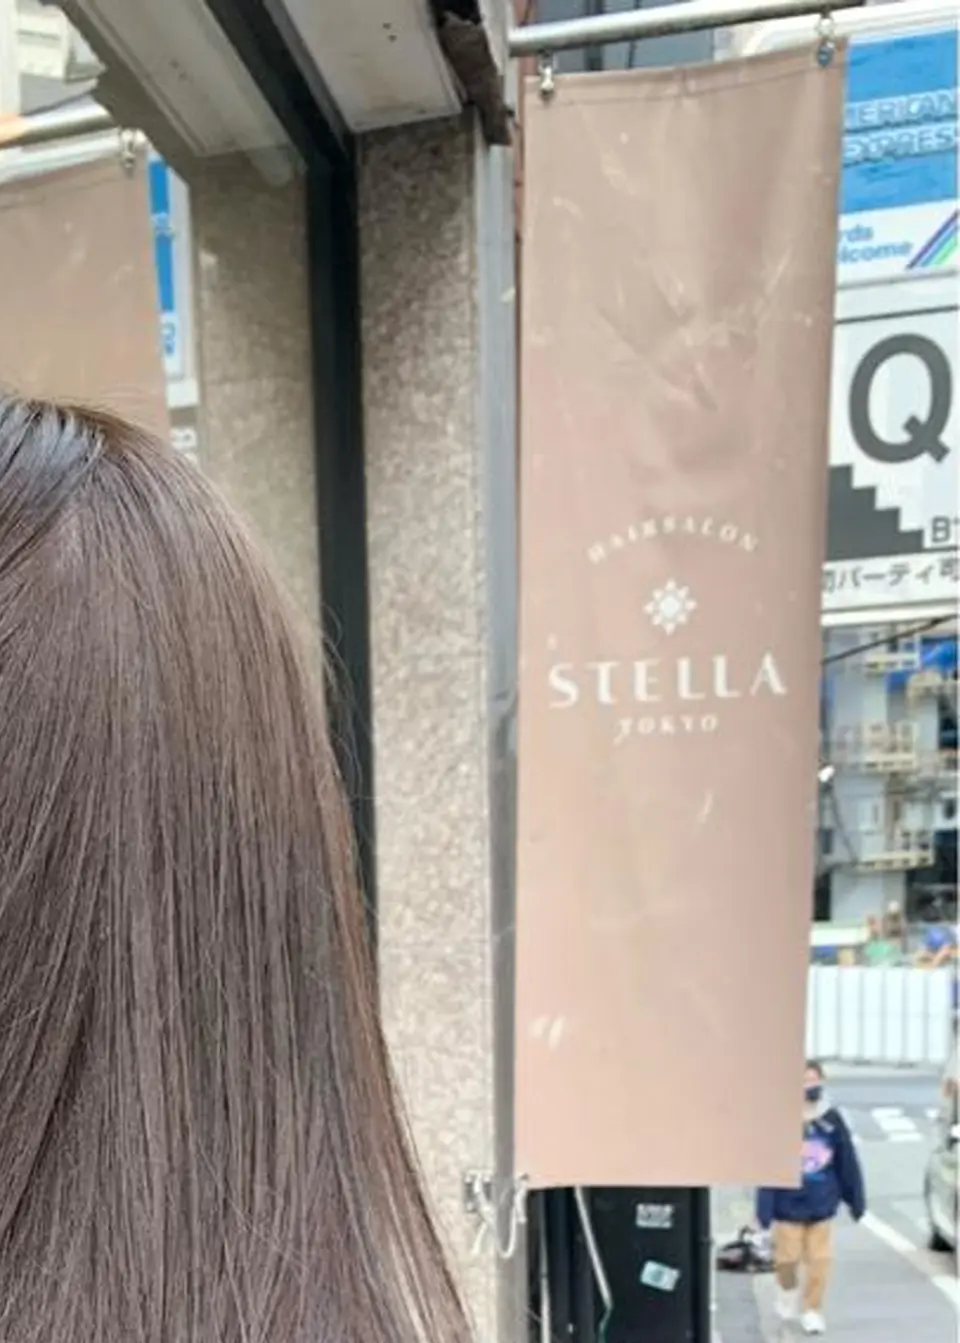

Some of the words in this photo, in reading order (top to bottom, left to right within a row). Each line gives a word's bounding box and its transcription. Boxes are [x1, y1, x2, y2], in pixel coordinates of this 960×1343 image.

[848, 332, 953, 464] Q
[931, 516, 958, 543] B
[547, 652, 788, 709] STELLA
